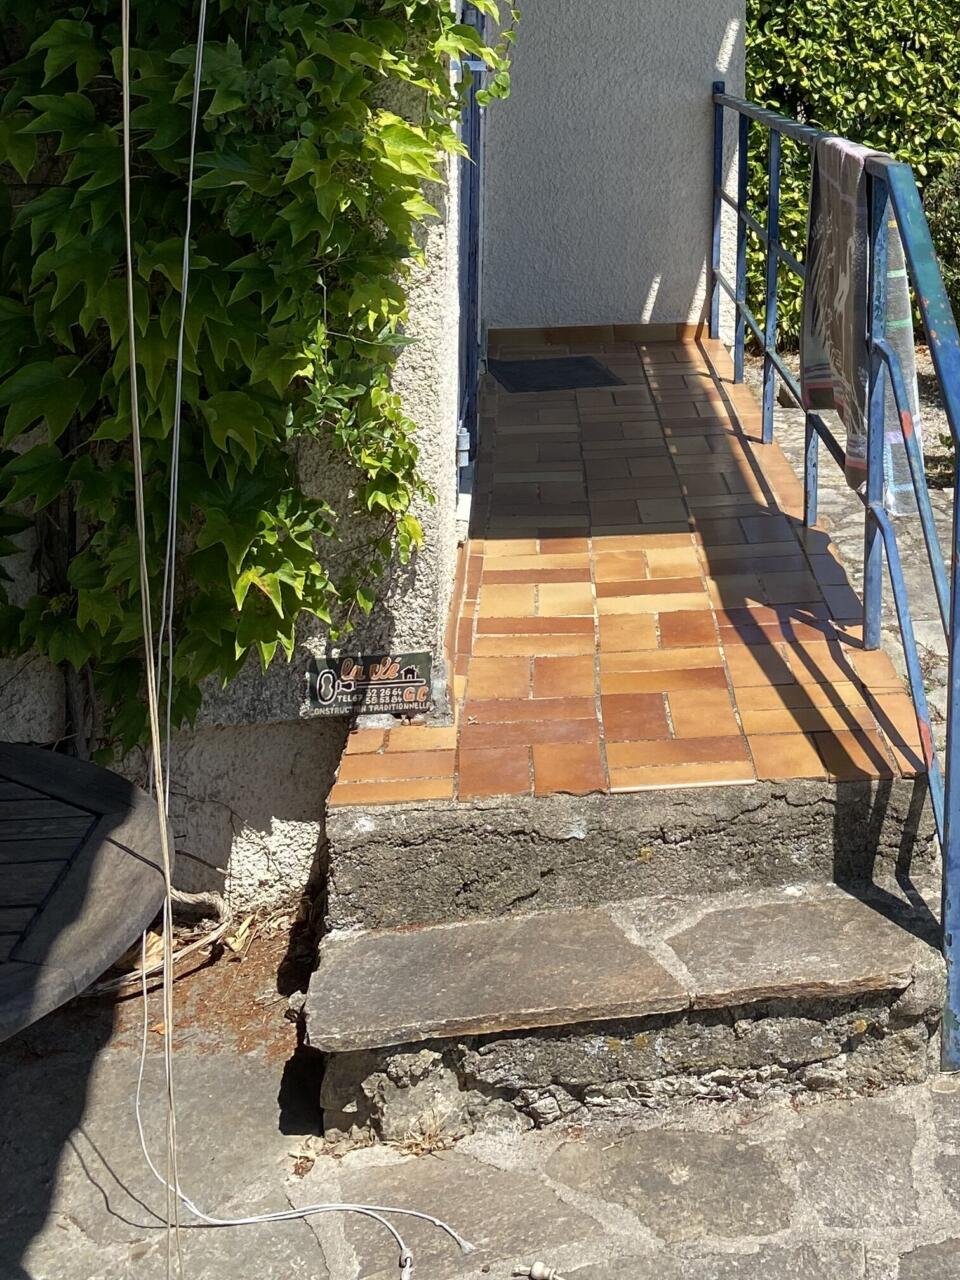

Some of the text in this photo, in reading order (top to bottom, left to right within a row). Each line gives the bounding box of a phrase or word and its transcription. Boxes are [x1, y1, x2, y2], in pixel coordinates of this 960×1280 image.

[379, 688, 391, 697] 26
[337, 694, 352, 703] TEL
[310, 705, 367, 715] CONSTRUCTN
